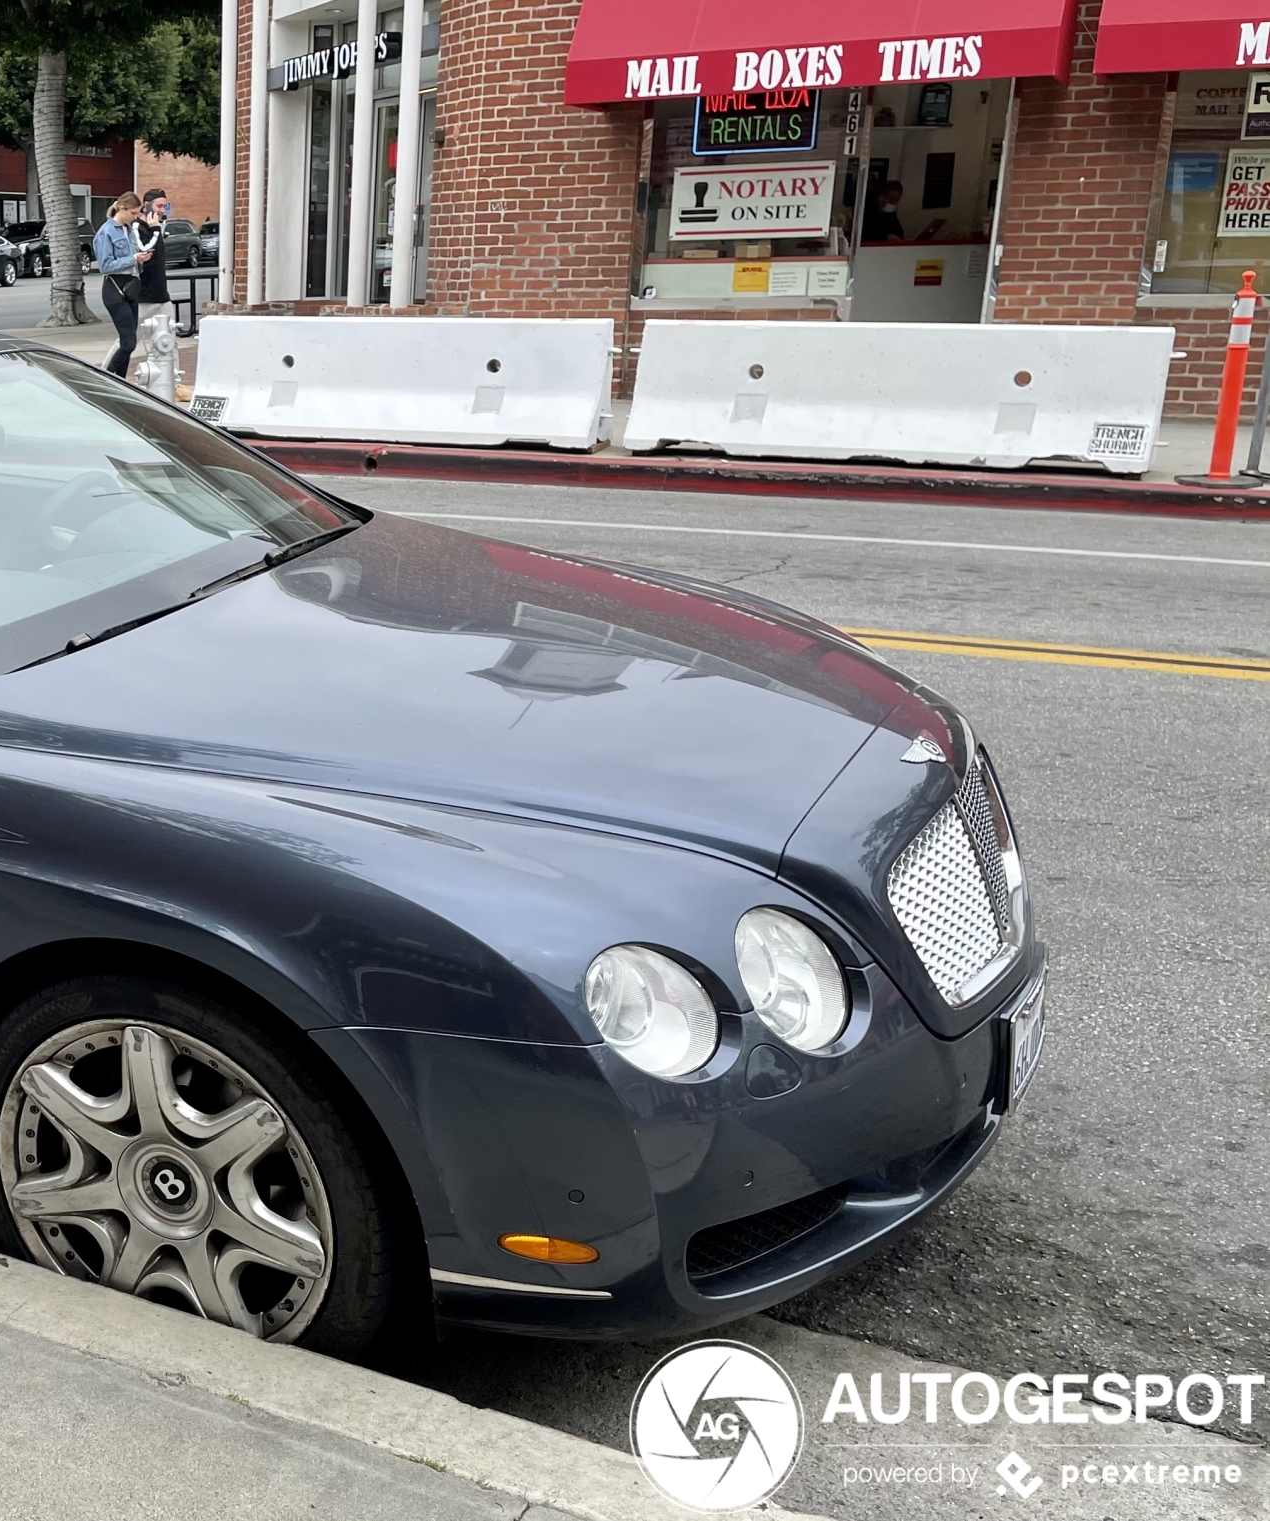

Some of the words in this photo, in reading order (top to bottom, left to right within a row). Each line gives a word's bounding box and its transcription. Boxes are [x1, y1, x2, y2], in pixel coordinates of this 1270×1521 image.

[1236, 22, 1270, 65] M
[283, 49, 330, 91] JIMMY
[625, 56, 702, 98] MAIL
[733, 44, 843, 92] BOXES
[879, 35, 983, 82] TIMES
[710, 114, 803, 144] RENTALS
[1234, 156, 1259, 164] While
[1232, 166, 1265, 180] GET
[718, 177, 826, 199] NOTARY
[732, 206, 758, 221] ON
[764, 204, 807, 219] SITE
[1225, 213, 1270, 228] HERE
[192, 399, 226, 410] TRENCH
[1095, 428, 1145, 440] TRENCH
[1090, 440, 1142, 451] SHORING
[154, 1169, 185, 1199] B
